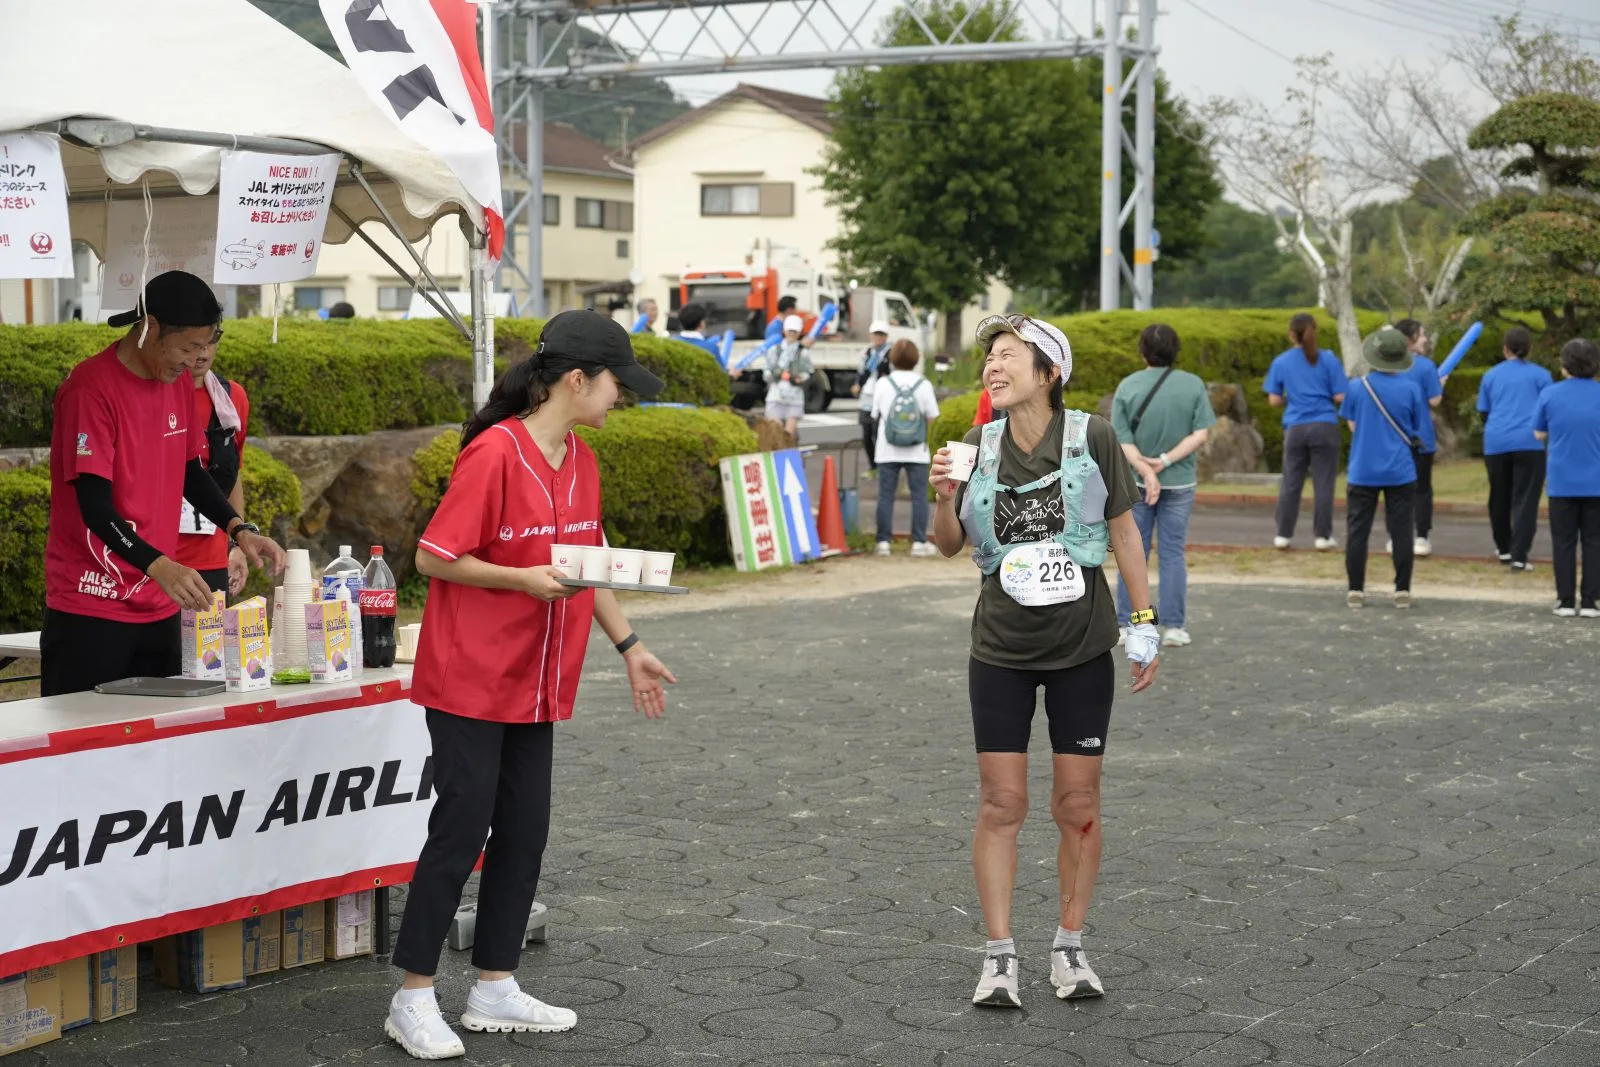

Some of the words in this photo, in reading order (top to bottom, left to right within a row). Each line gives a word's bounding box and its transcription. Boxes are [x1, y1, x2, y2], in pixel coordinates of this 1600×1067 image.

[269, 166, 291, 178] NICE
[248, 181, 268, 193] JAL
[271, 182, 325, 195] オリジナルドリンク
[238, 196, 280, 208] スカイタイム
[744, 461, 775, 563] 駐車場
[1021, 508, 1048, 521] North
[80, 570, 100, 585] JAL
[1039, 561, 1075, 583] 226
[359, 592, 396, 608] Coca-Cola
[0, 790, 245, 887] JAPAN
